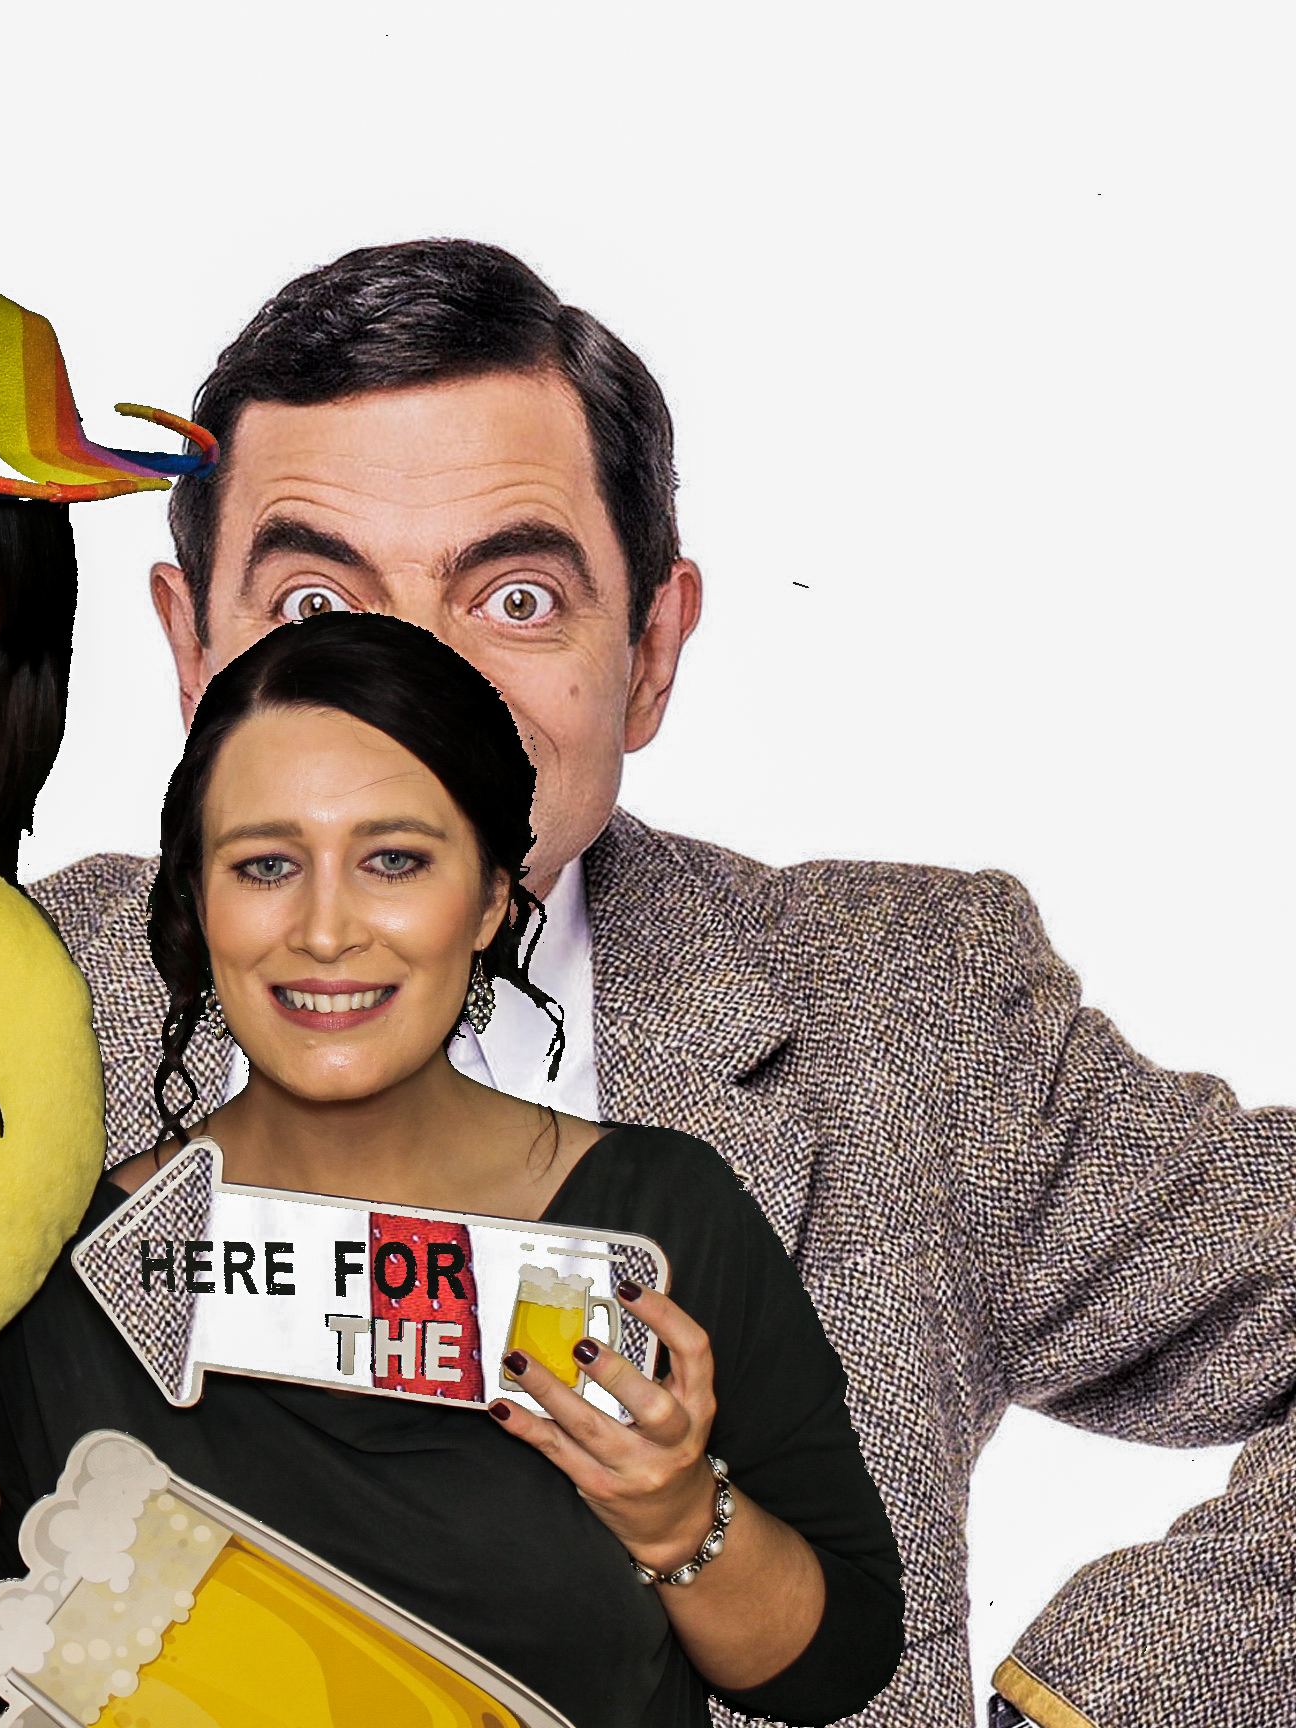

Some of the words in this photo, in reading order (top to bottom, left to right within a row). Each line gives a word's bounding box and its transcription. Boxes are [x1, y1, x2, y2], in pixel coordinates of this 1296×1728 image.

[141, 1240, 295, 1295] HERE
[334, 1241, 468, 1300] FOR
[325, 1314, 462, 1382] THE
